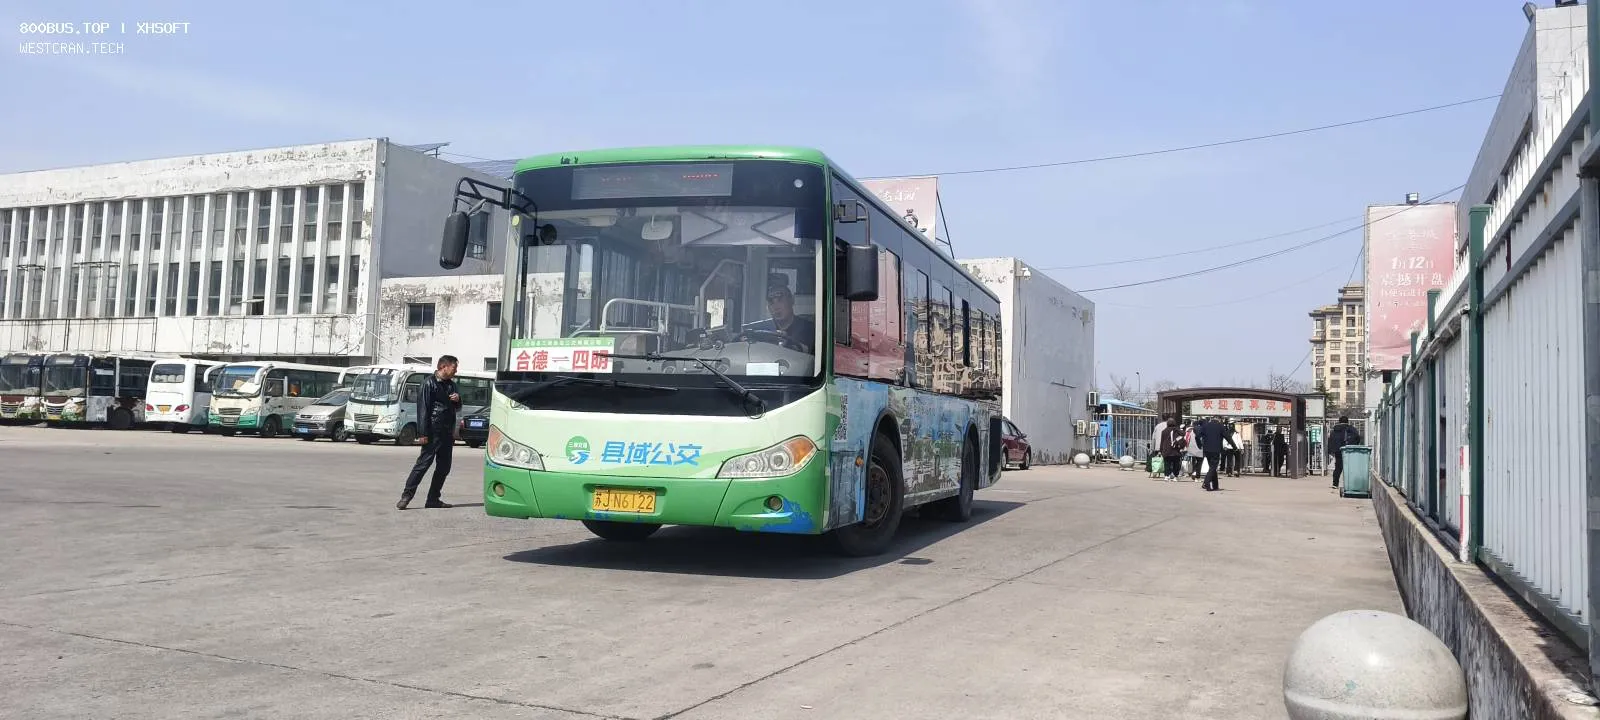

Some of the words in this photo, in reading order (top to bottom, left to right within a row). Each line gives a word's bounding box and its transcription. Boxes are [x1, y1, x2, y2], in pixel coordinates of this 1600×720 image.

[516, 350, 549, 370] 合德
[572, 350, 609, 370] 四明
[601, 441, 703, 466] 县域公交
